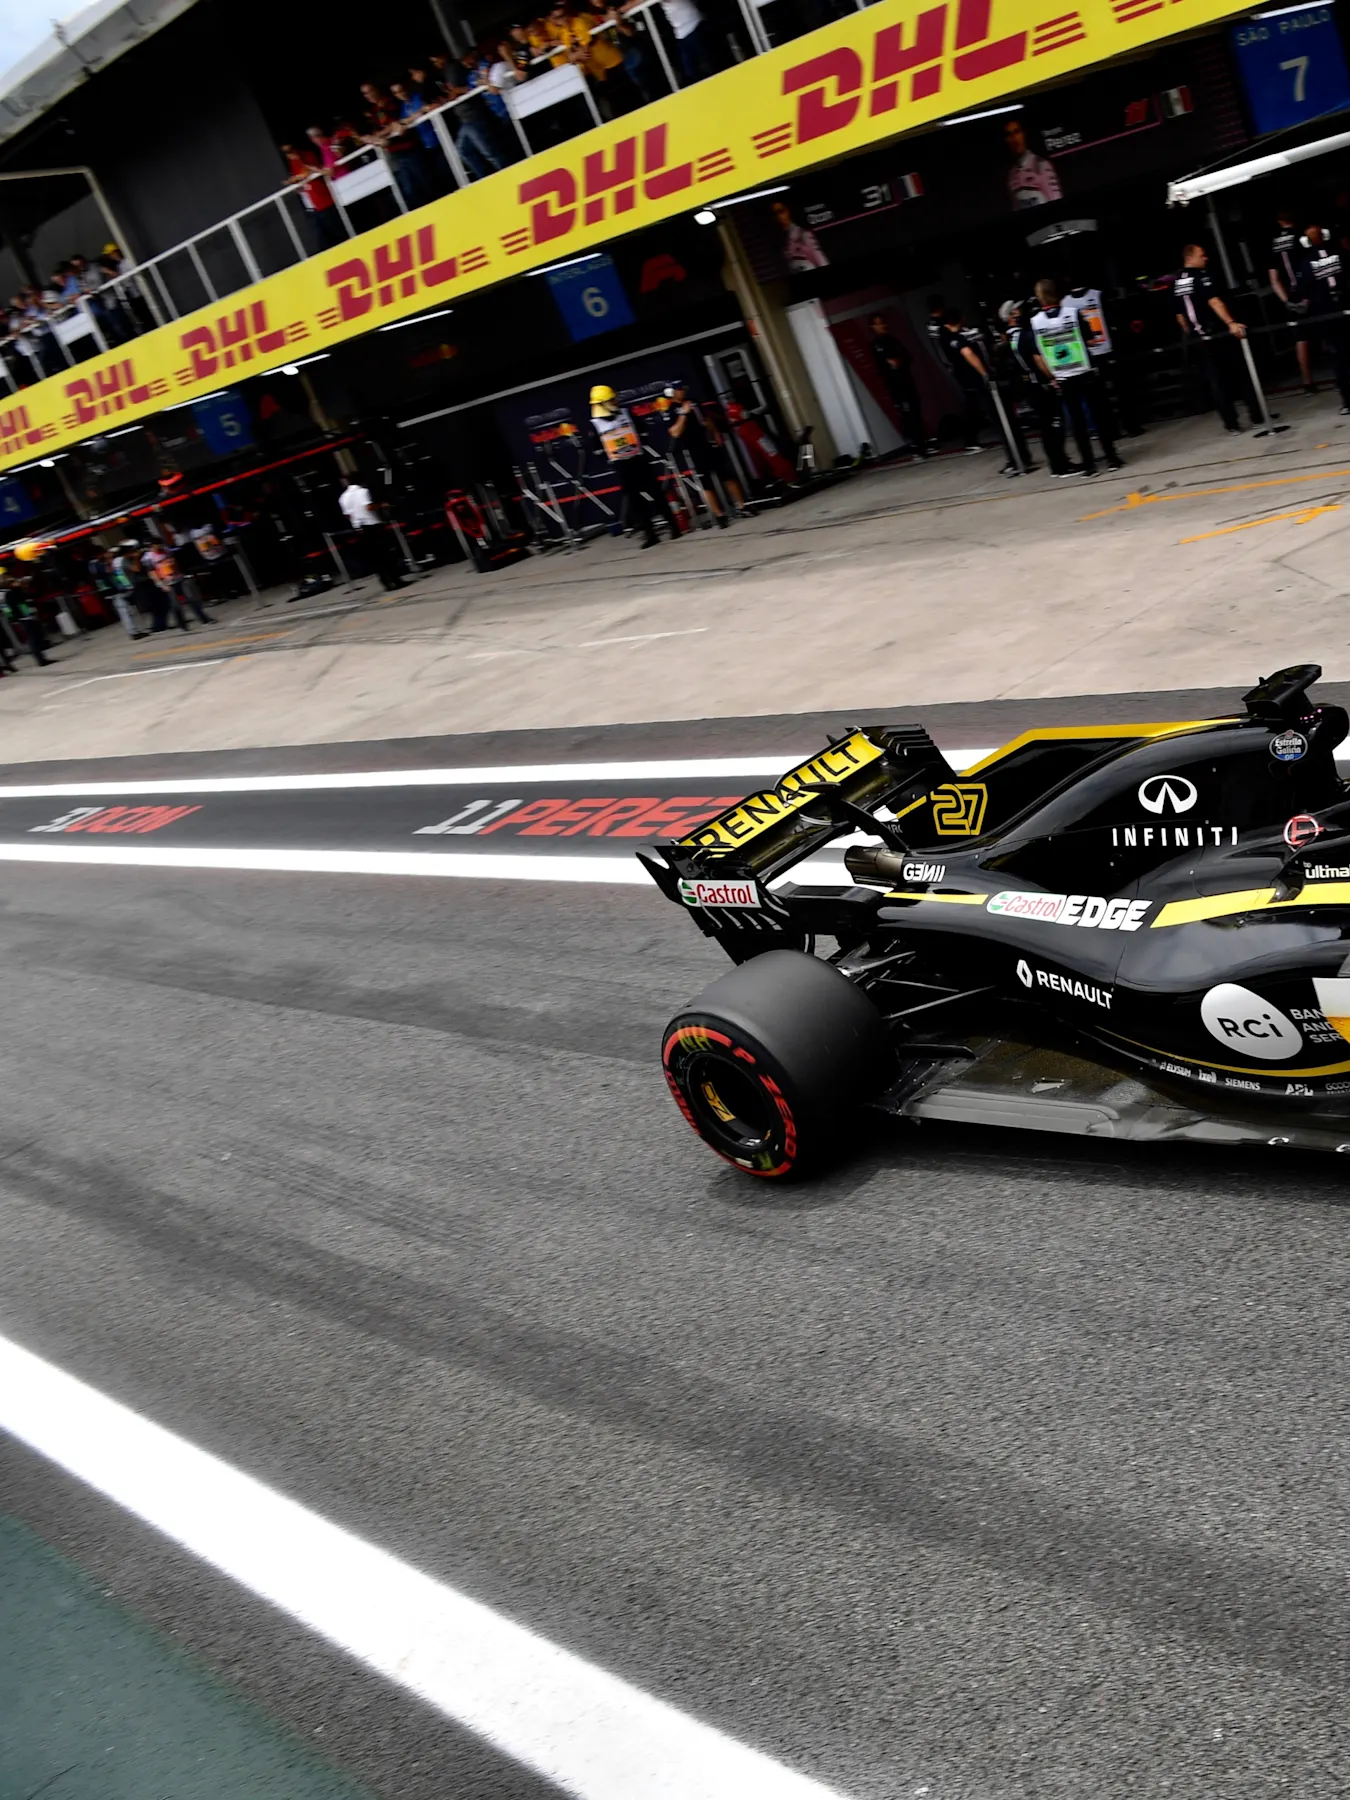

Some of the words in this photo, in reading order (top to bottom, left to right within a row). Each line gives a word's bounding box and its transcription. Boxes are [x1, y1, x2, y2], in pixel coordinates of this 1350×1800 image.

[1277, 8, 1331, 36] PAULO
[783, 0, 1027, 145] DHL
[1278, 55, 1310, 102] 7
[518, 123, 693, 246] DHL
[860, 183, 892, 208] 31
[325, 223, 457, 322] DHL
[581, 287, 610, 318] 6
[180, 300, 286, 380] DHL
[64, 358, 150, 425] DHL
[0, 405, 43, 454] HL
[219, 413, 241, 437] 5
[930, 783, 988, 835] 27
[1112, 826, 1238, 846] INFINITI
[696, 883, 755, 904] Castrol
[1004, 895, 1062, 918] Castrol
[1056, 895, 1153, 931] EDGE
[1036, 970, 1112, 1009] RENAULT
[1217, 1014, 1283, 1038] RCi
[1290, 1009, 1324, 1020] BAN
[1310, 1033, 1343, 1043] SER
[1225, 1077, 1261, 1091] SIEMENS
